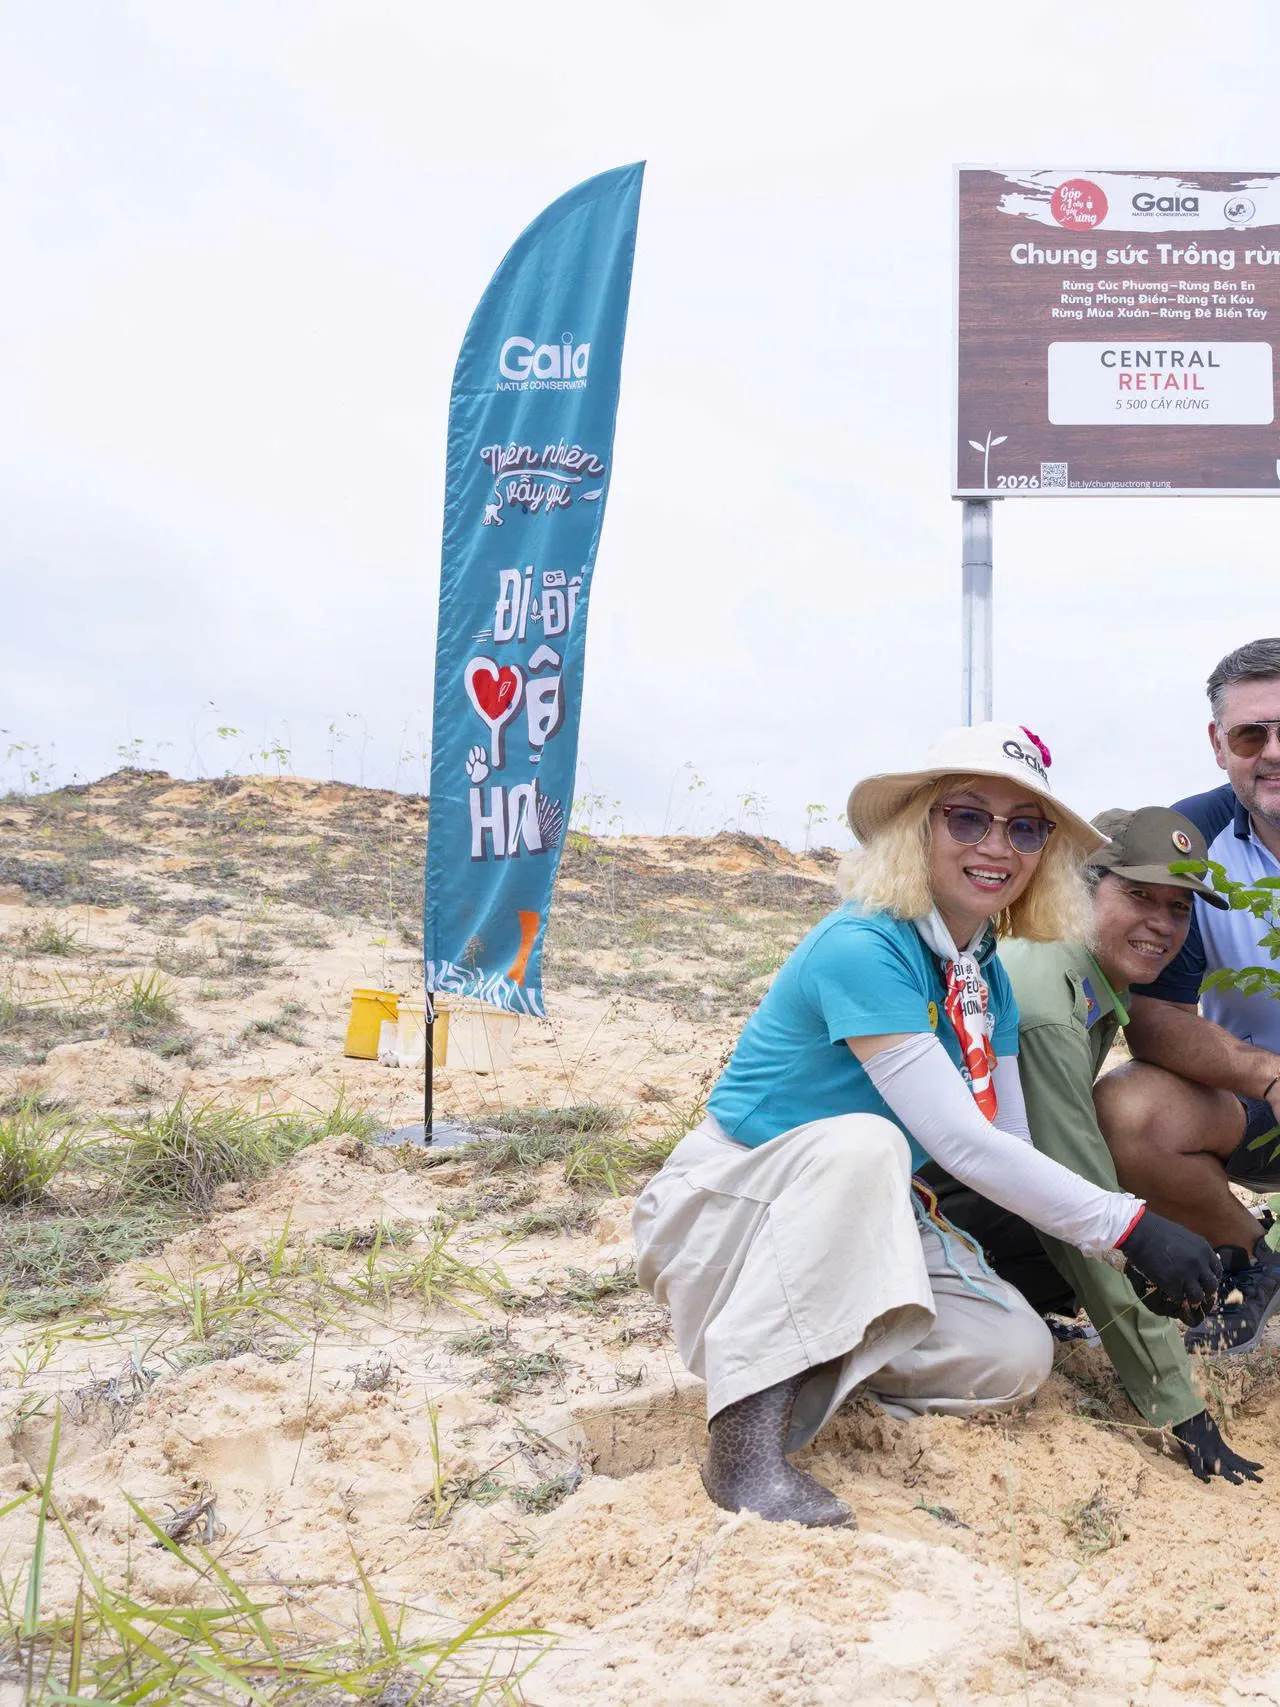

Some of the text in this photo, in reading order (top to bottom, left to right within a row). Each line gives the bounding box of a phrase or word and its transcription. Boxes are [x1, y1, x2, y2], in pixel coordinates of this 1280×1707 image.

[1131, 191, 1199, 213] Gaia
[1010, 243, 1098, 270] Chung
[1106, 245, 1149, 265] sức
[1156, 241, 1236, 271] Trồng
[1062, 280, 1094, 293] Rừng
[1098, 280, 1119, 291] Cúc
[1213, 280, 1237, 291] Bến
[1240, 281, 1256, 291] En
[1060, 294, 1092, 306] Rừng
[1095, 293, 1135, 306] Phong
[1211, 294, 1227, 305] Tà
[1051, 308, 1083, 320] Rừng
[1086, 307, 1114, 318] Mùa
[1194, 308, 1212, 318] Đê
[1215, 306, 1243, 318] Biển
[1245, 308, 1268, 320] Tây
[499, 332, 592, 381] Gaia
[1101, 350, 1221, 368] CENTRAL
[1118, 373, 1205, 390] RETAIL
[1126, 399, 1148, 410] 500
[1150, 396, 1173, 410] CÂY
[1175, 396, 1210, 410] RỪNG
[996, 475, 1040, 489] 2026
